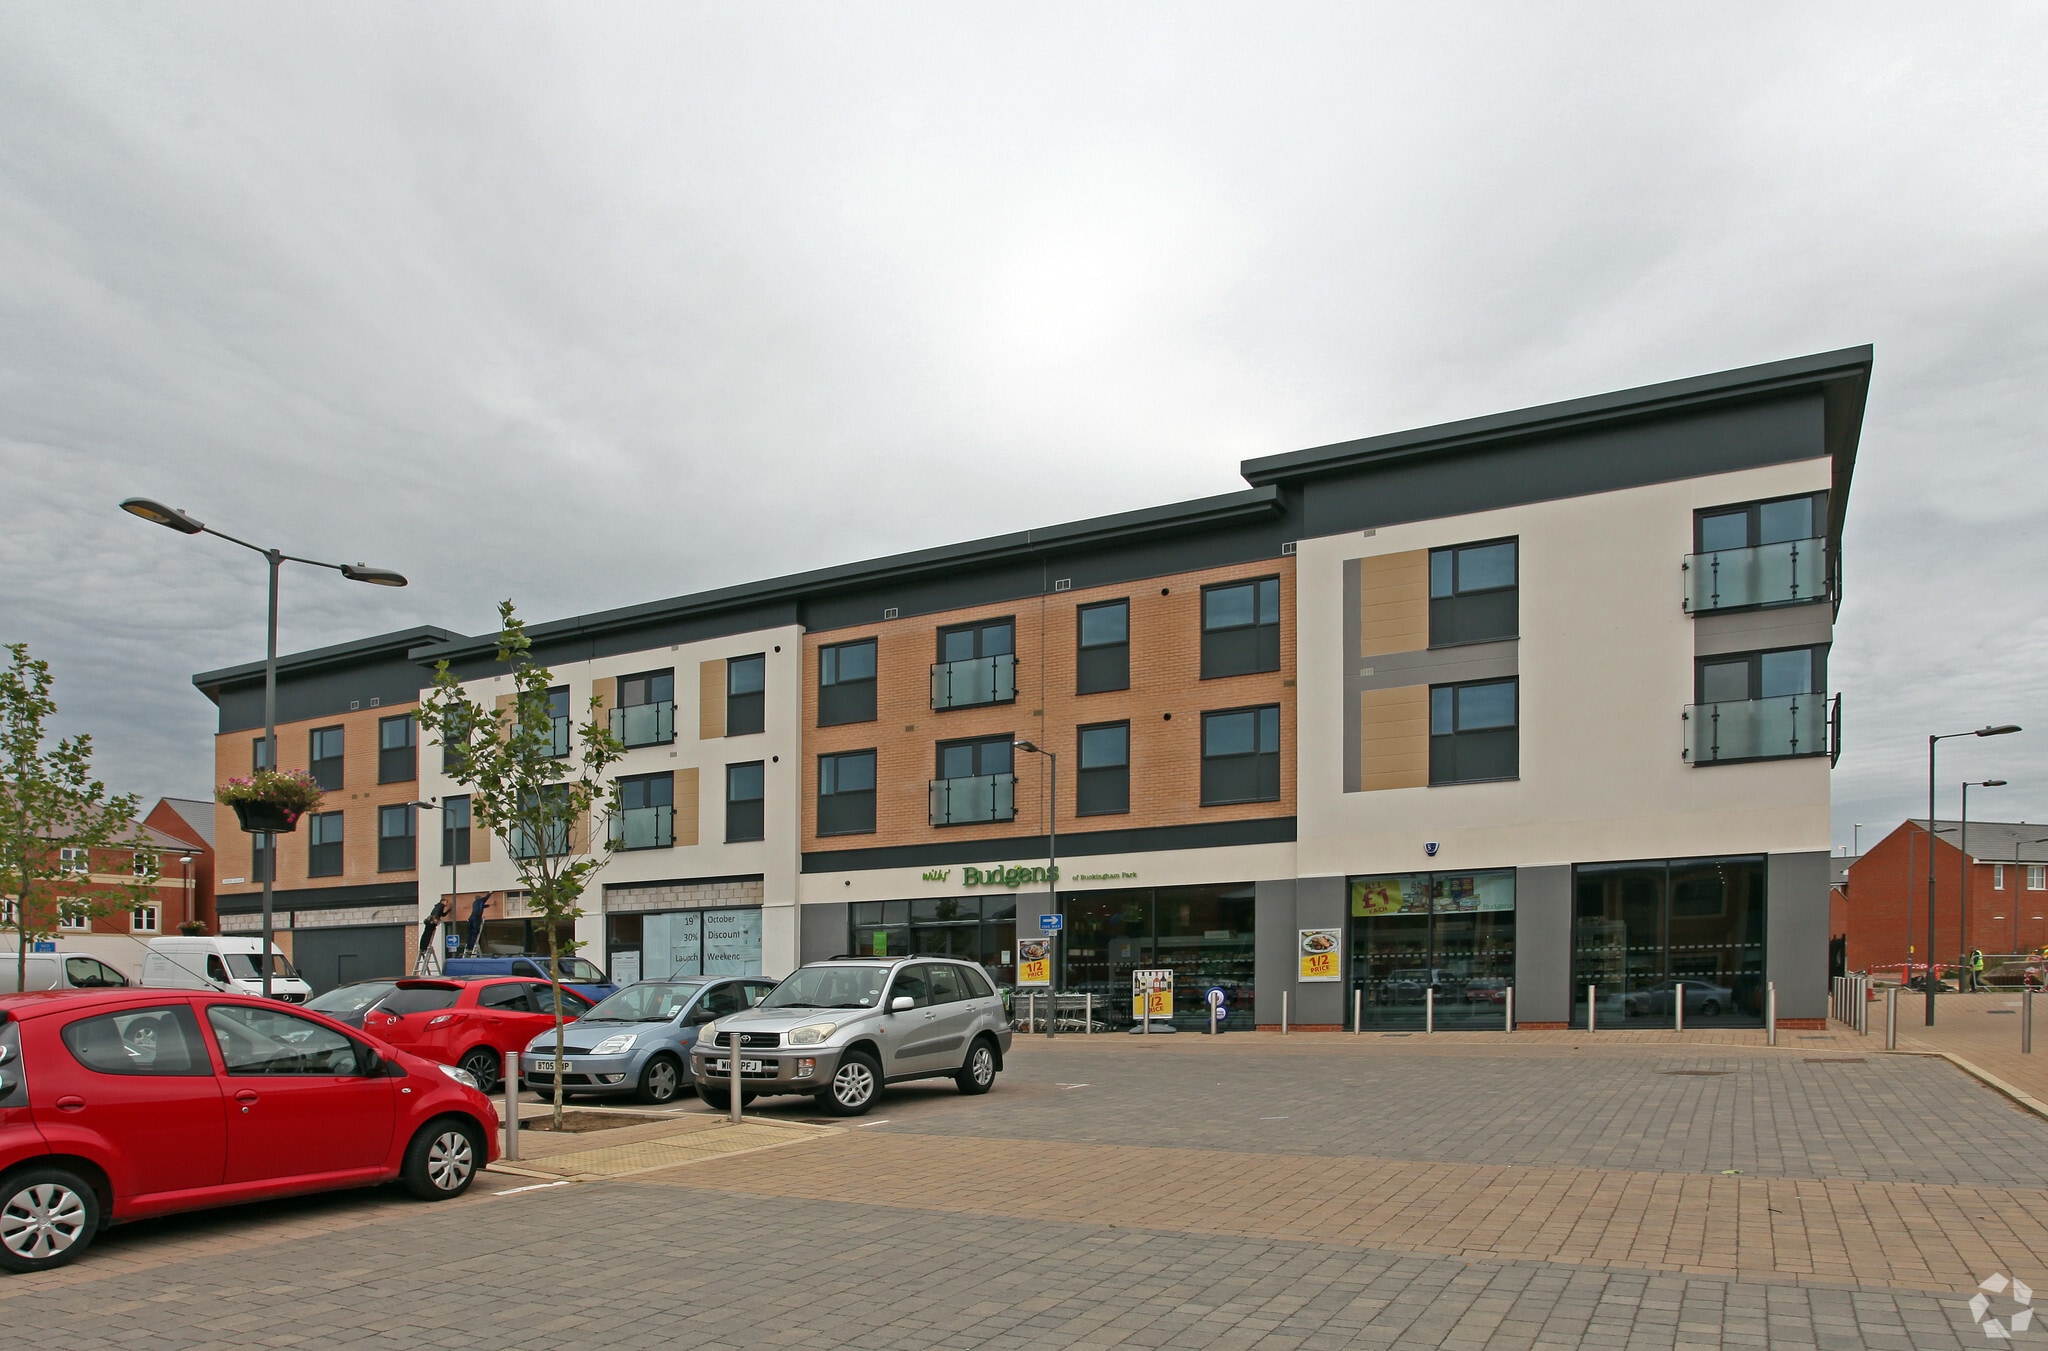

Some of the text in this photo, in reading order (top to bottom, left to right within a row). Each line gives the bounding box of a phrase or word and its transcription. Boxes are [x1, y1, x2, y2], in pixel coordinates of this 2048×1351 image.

[962, 864, 1060, 888] Budgens
[1080, 872, 1120, 881] Buckingham
[1121, 871, 1137, 879] Park
[1365, 881, 1384, 890] ALL
[1362, 888, 1390, 909] £1
[1369, 906, 1388, 915] EACH
[707, 915, 736, 924] October
[684, 933, 699, 942] 30%
[1309, 954, 1329, 967] 1/2
[1027, 961, 1043, 973] 1/2
[1310, 965, 1330, 974] PRICE
[1150, 996, 1163, 1007] /2
[740, 1061, 757, 1071] PFJ
